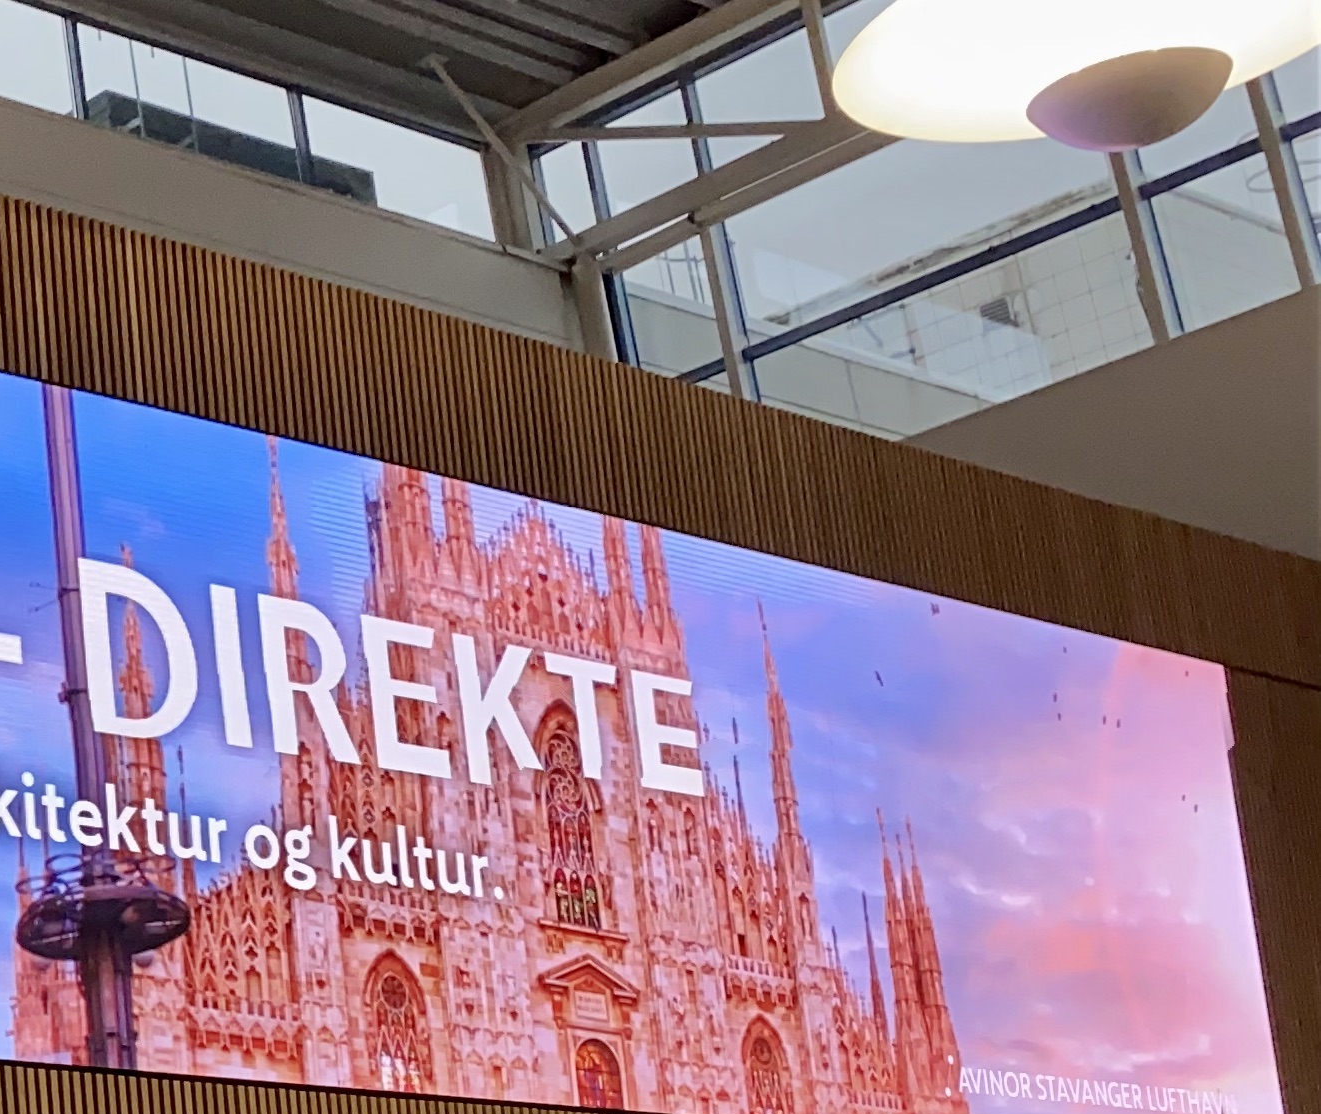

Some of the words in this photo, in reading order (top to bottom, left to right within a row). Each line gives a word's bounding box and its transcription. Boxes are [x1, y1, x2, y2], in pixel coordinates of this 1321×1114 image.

[76, 556, 708, 799] DIREKTE
[248, 824, 316, 891] og
[328, 814, 506, 900] kultur.
[959, 1067, 1033, 1100] AVINOR
[1036, 1075, 1144, 1111] STAVANGER
